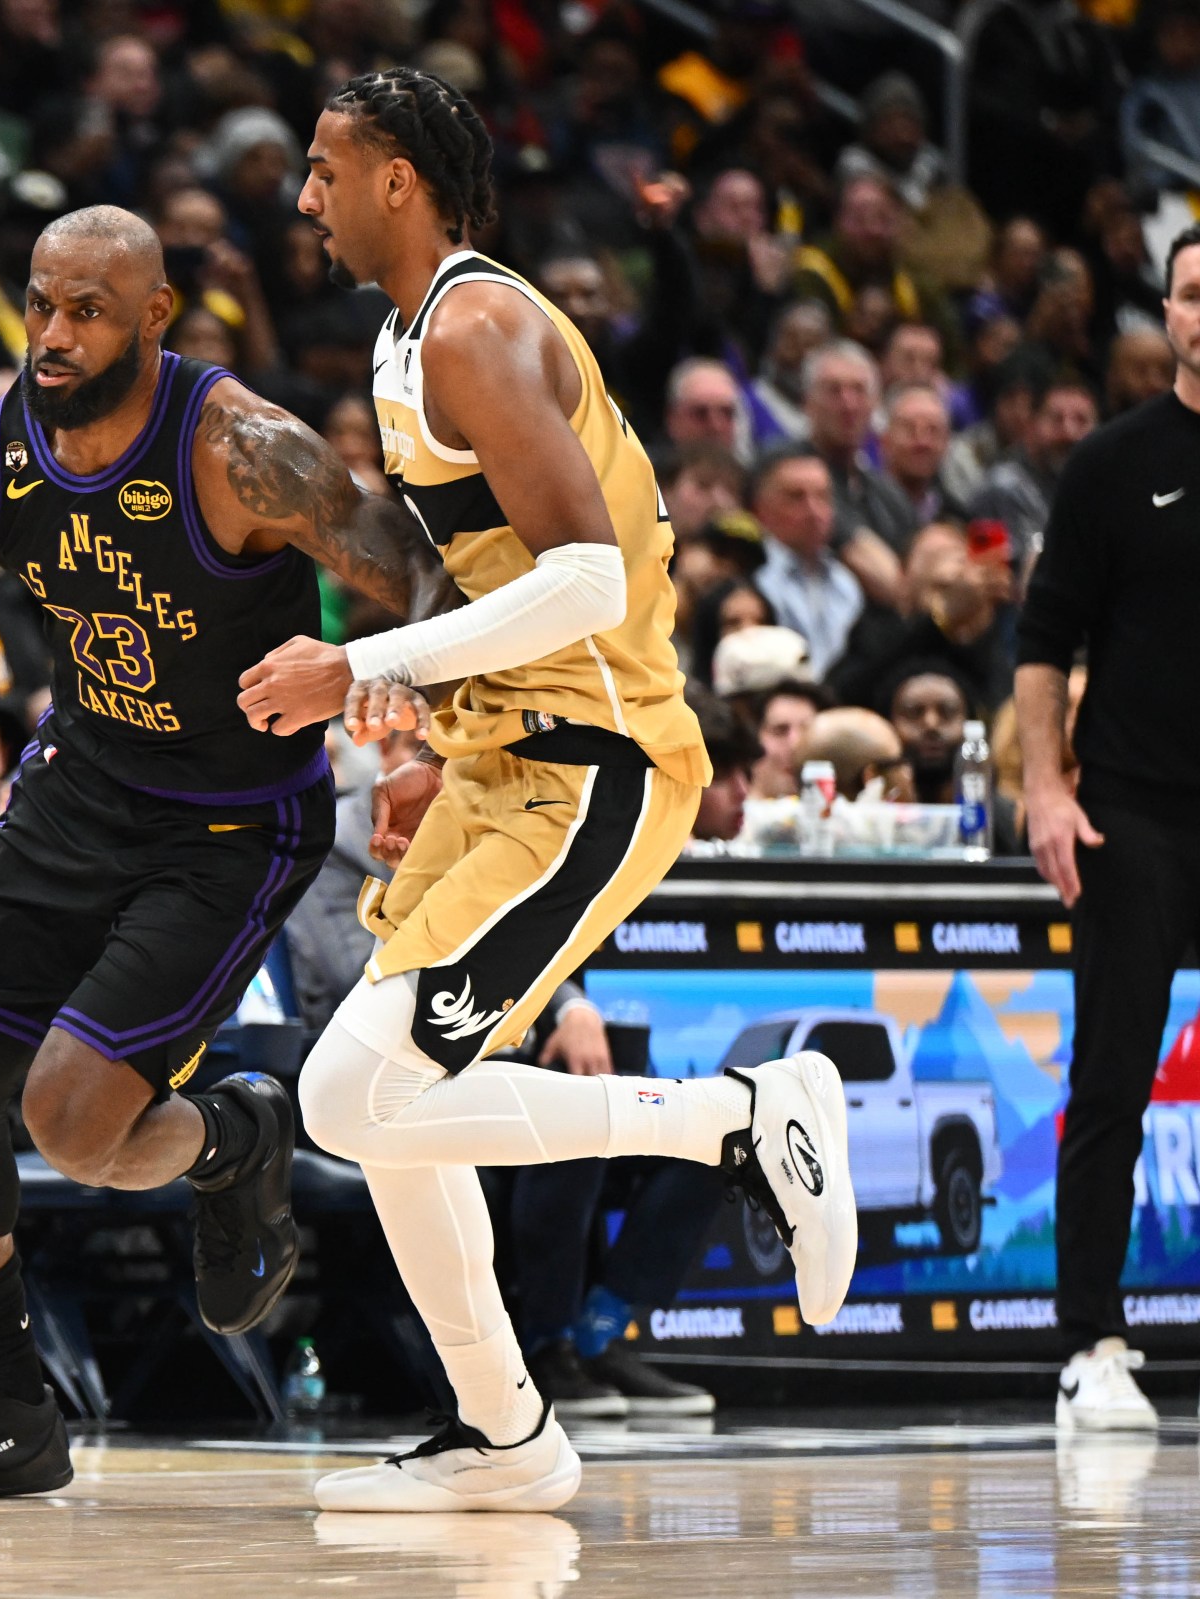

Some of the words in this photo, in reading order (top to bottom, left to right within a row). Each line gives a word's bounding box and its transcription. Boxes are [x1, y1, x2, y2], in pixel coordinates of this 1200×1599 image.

[123, 490, 170, 510] bibigo
[131, 504, 152, 512] 비비고
[58, 512, 198, 642] ANGELES
[42, 603, 157, 694] 23
[77, 670, 181, 733] LAKERS
